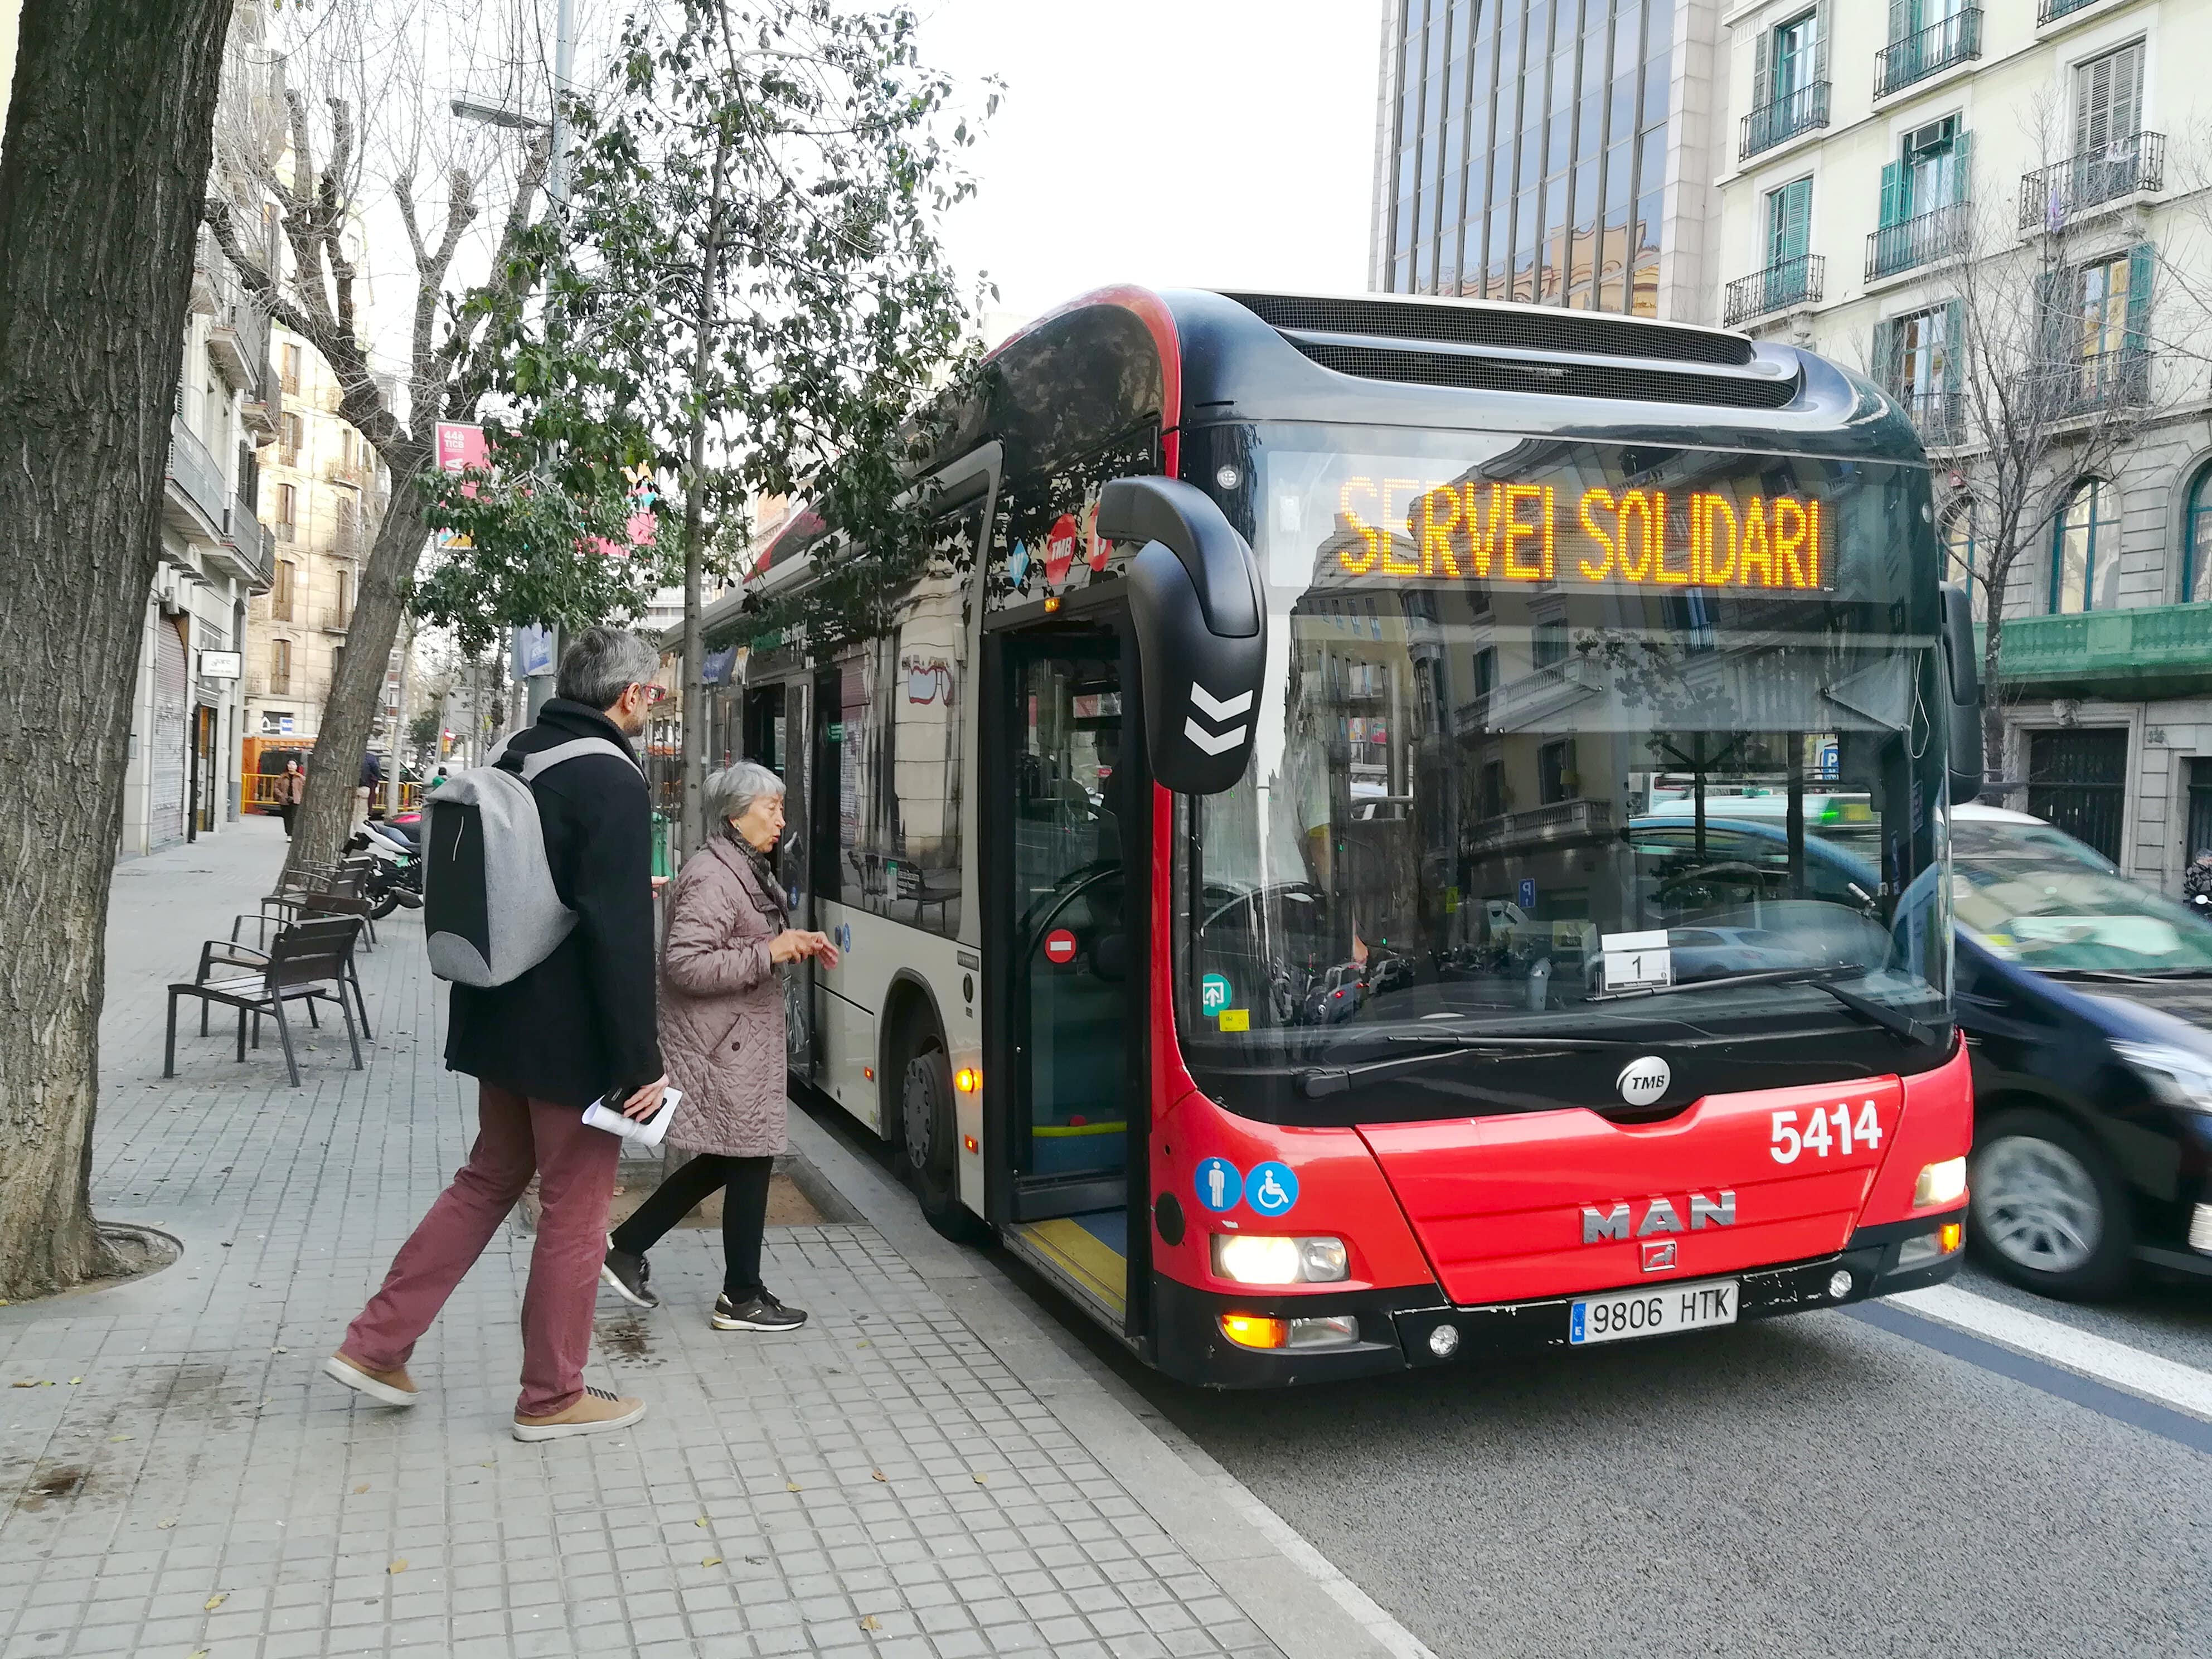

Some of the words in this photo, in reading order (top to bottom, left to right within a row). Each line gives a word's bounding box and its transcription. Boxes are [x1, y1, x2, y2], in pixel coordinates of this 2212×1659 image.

[444, 430, 464, 440] 44è
[444, 439, 464, 448] TICB
[1339, 476, 1554, 579] SERVEI
[1579, 487, 1820, 588] SOLIDARI
[1052, 536, 1072, 561] TMB
[1828, 753, 1837, 767] P
[1632, 955, 1641, 978] 1
[1632, 1075, 1665, 1089] TMB
[1770, 1100, 1883, 1164] 5414
[1582, 1191, 1736, 1244] MAN
[1575, 1326, 1582, 1336] E
[1593, 1297, 1663, 1333] 9806
[1681, 1288, 1730, 1323] HTK
